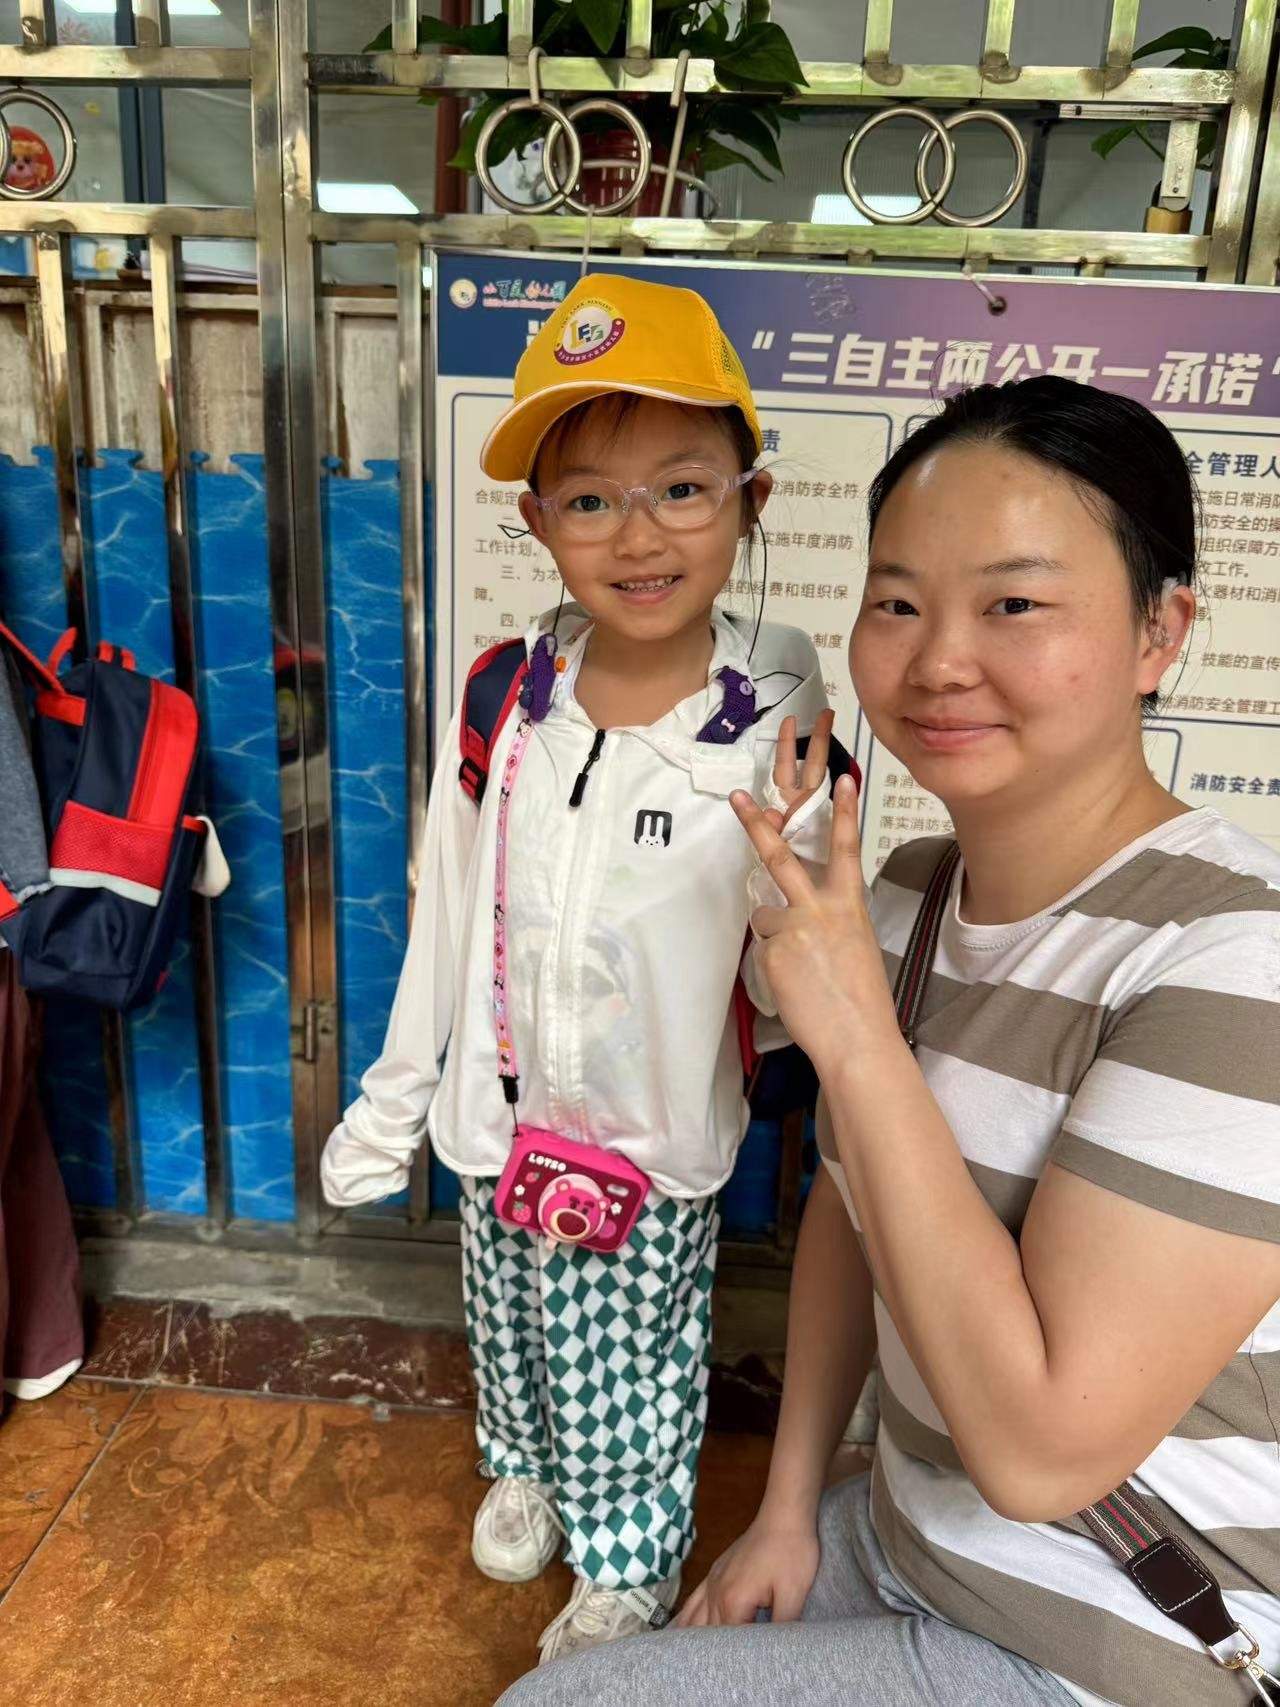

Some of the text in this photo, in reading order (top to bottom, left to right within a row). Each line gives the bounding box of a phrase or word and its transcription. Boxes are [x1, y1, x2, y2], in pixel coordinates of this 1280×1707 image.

[1186, 451, 1280, 478] 全管理人
[475, 487, 518, 505] 合规定
